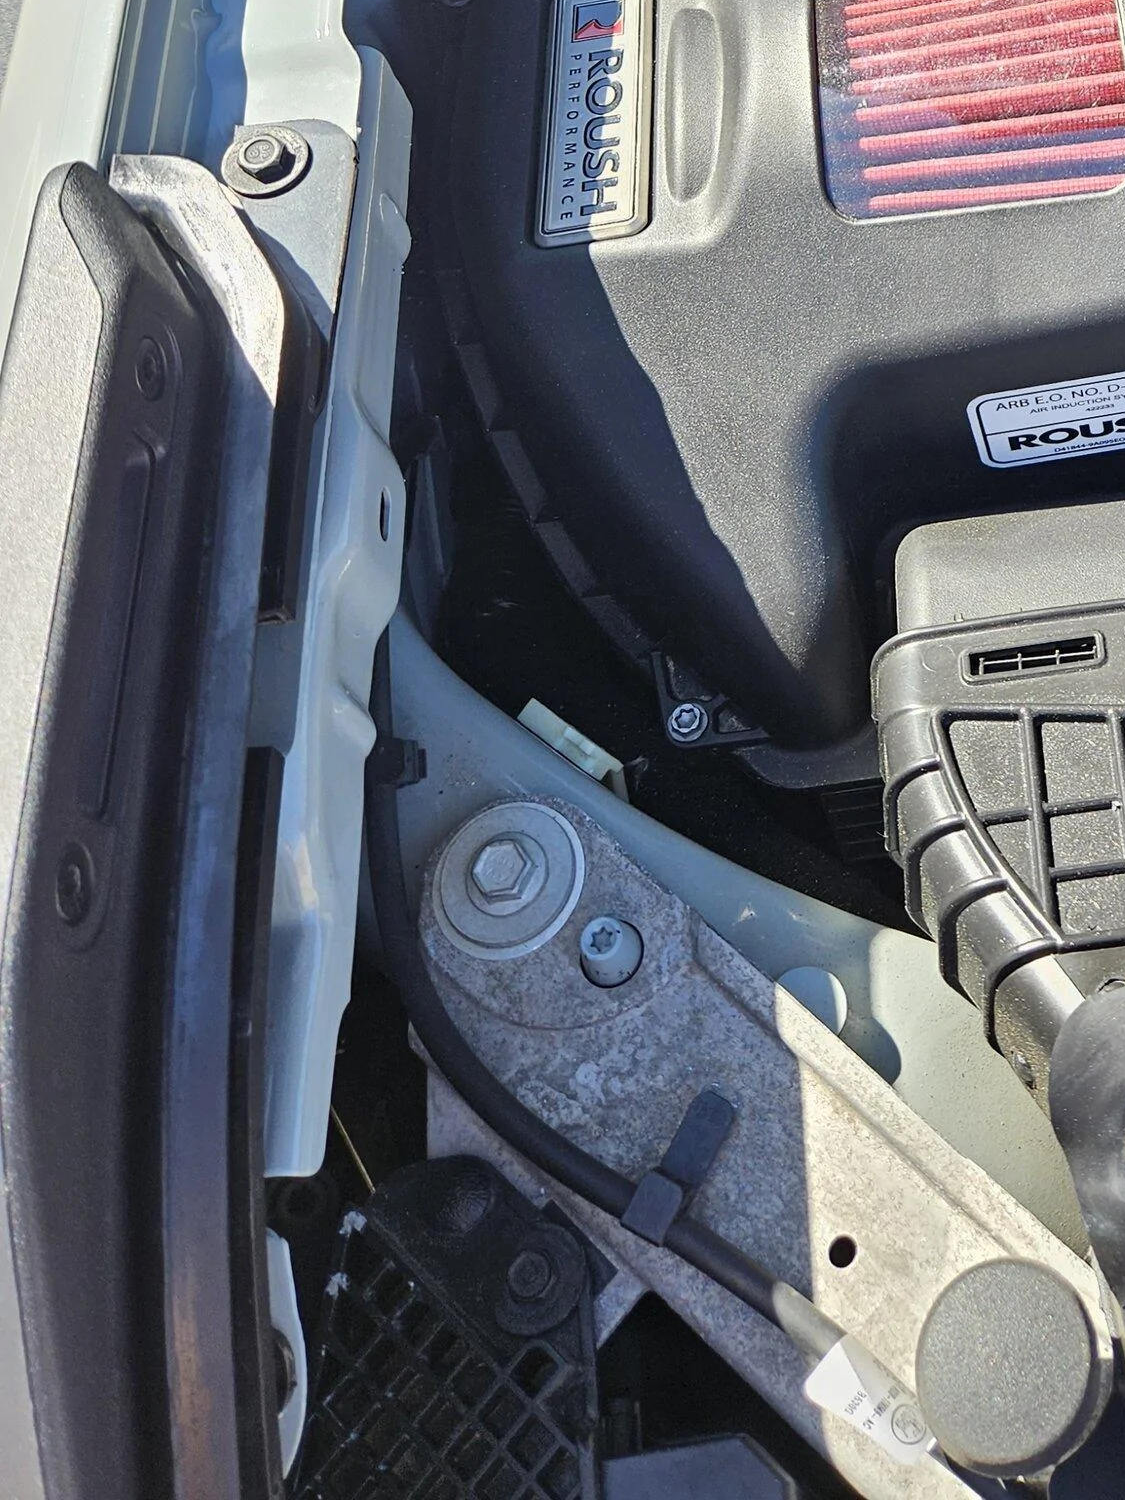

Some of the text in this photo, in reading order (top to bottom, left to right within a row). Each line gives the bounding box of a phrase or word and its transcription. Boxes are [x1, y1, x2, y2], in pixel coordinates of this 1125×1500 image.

[560, 53, 583, 220] PERFORMANCE
[580, 48, 624, 217] ROUSH
[995, 398, 1029, 411] ARB
[1035, 392, 1066, 405] E.O.
[1072, 387, 1103, 399] NO.
[1029, 406, 1049, 414] AIR
[1051, 396, 1111, 411] INDUCTION
